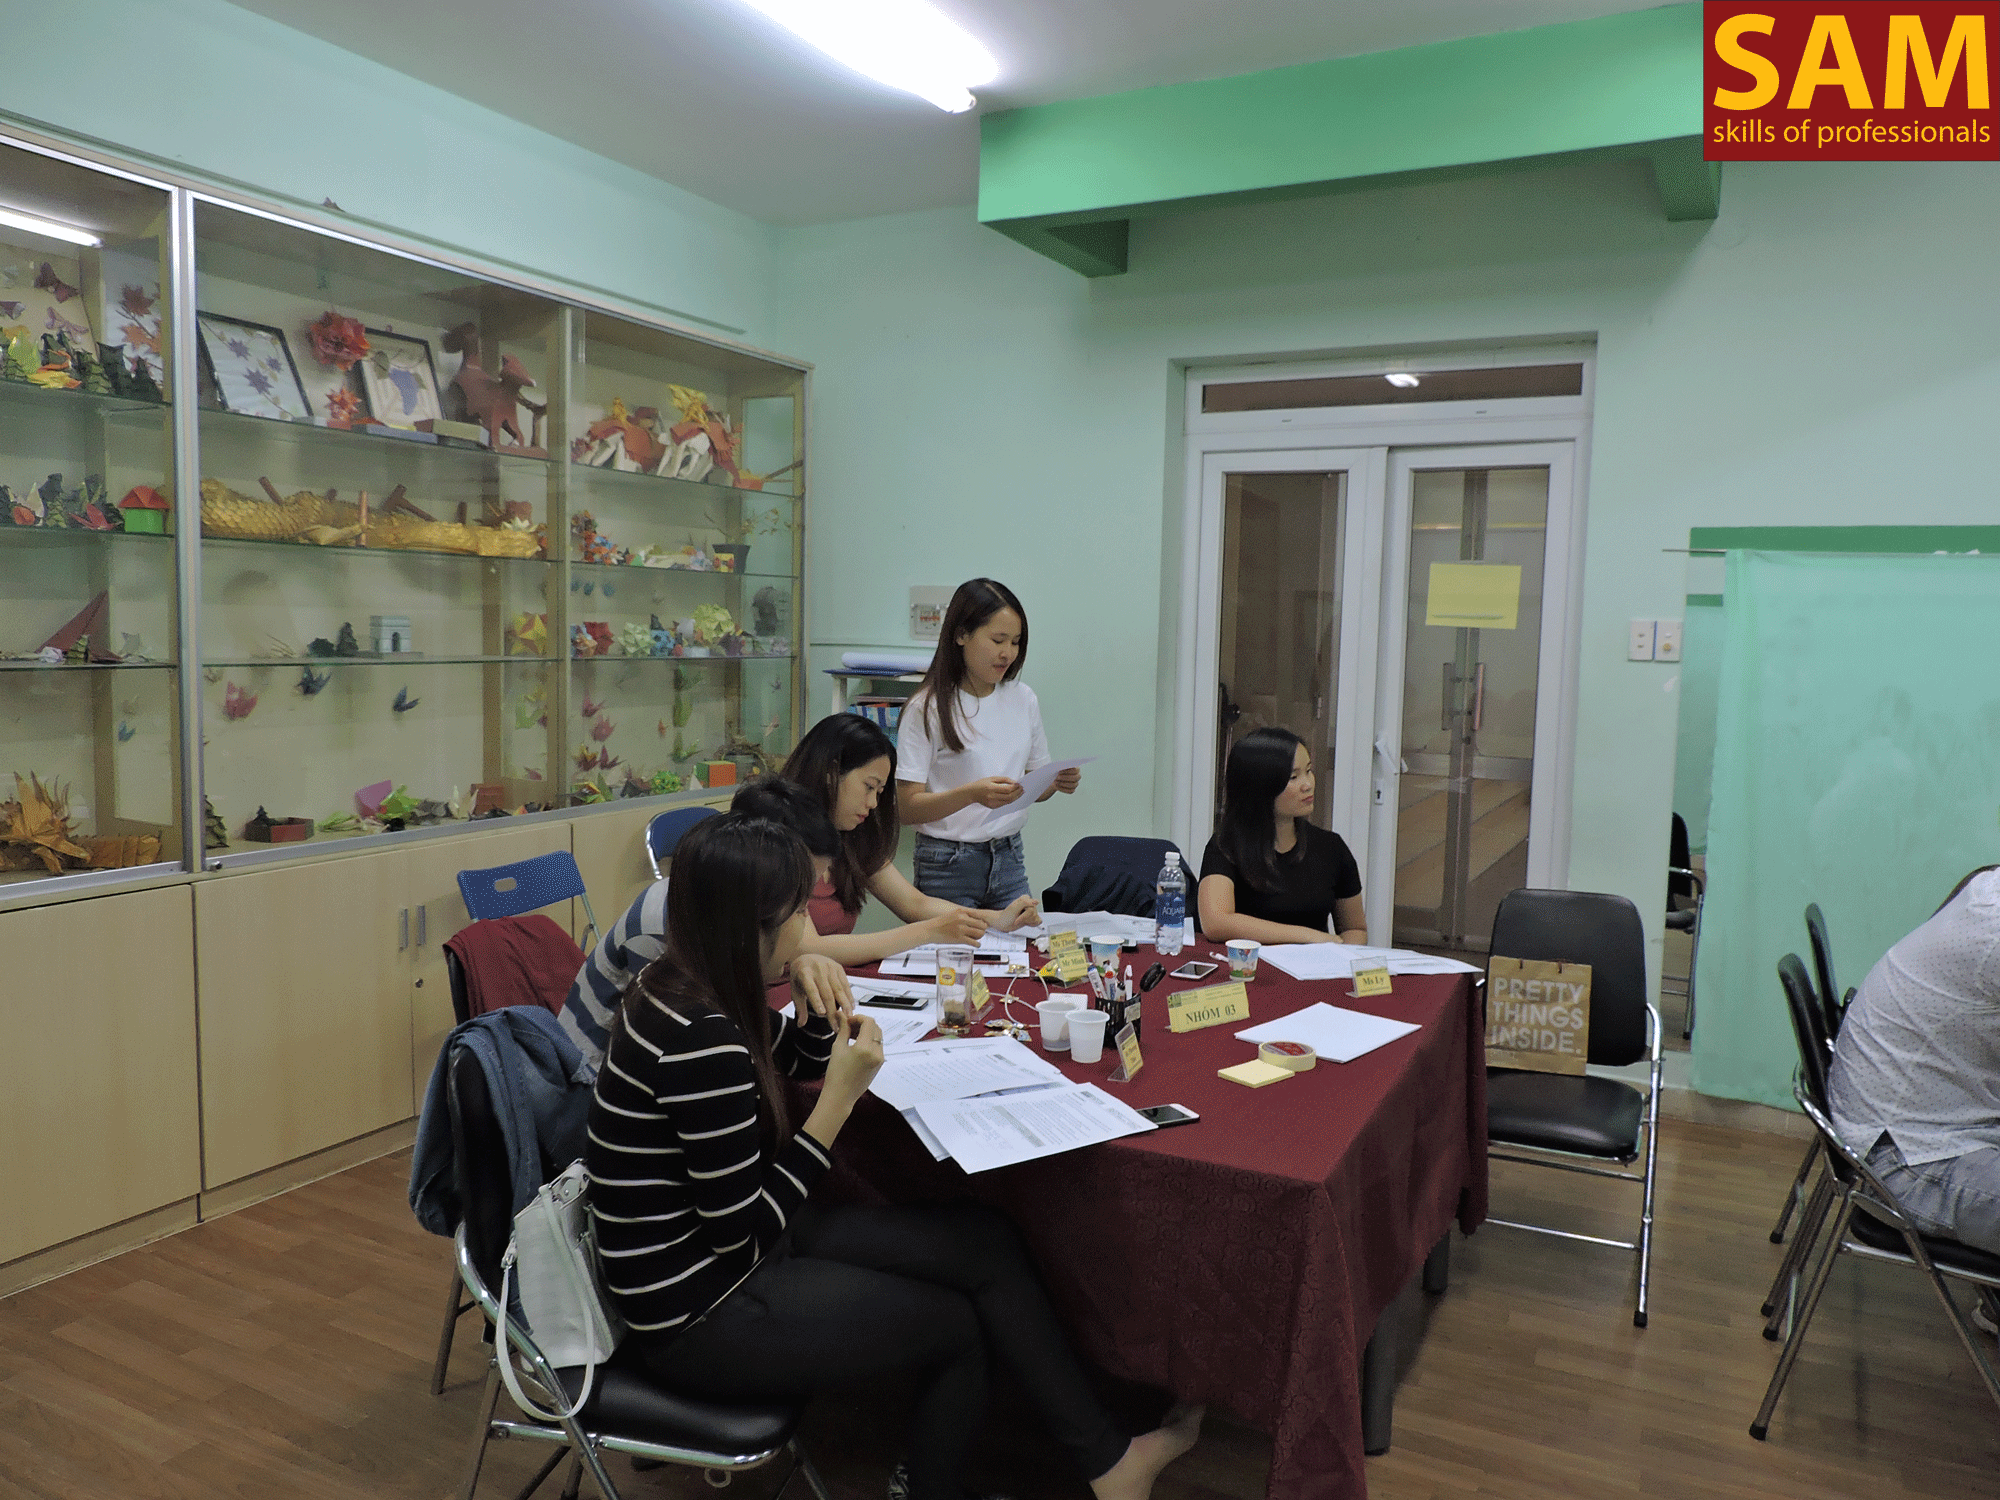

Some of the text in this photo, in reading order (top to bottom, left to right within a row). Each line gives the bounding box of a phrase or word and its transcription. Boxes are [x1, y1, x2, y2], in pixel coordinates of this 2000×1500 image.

[1494, 977, 1584, 1004] PRETTY
[1186, 1004, 1236, 1024] NHÓM 03
[1493, 1001, 1584, 1030] THINGS
[1491, 1025, 1582, 1054] INSIDE.
